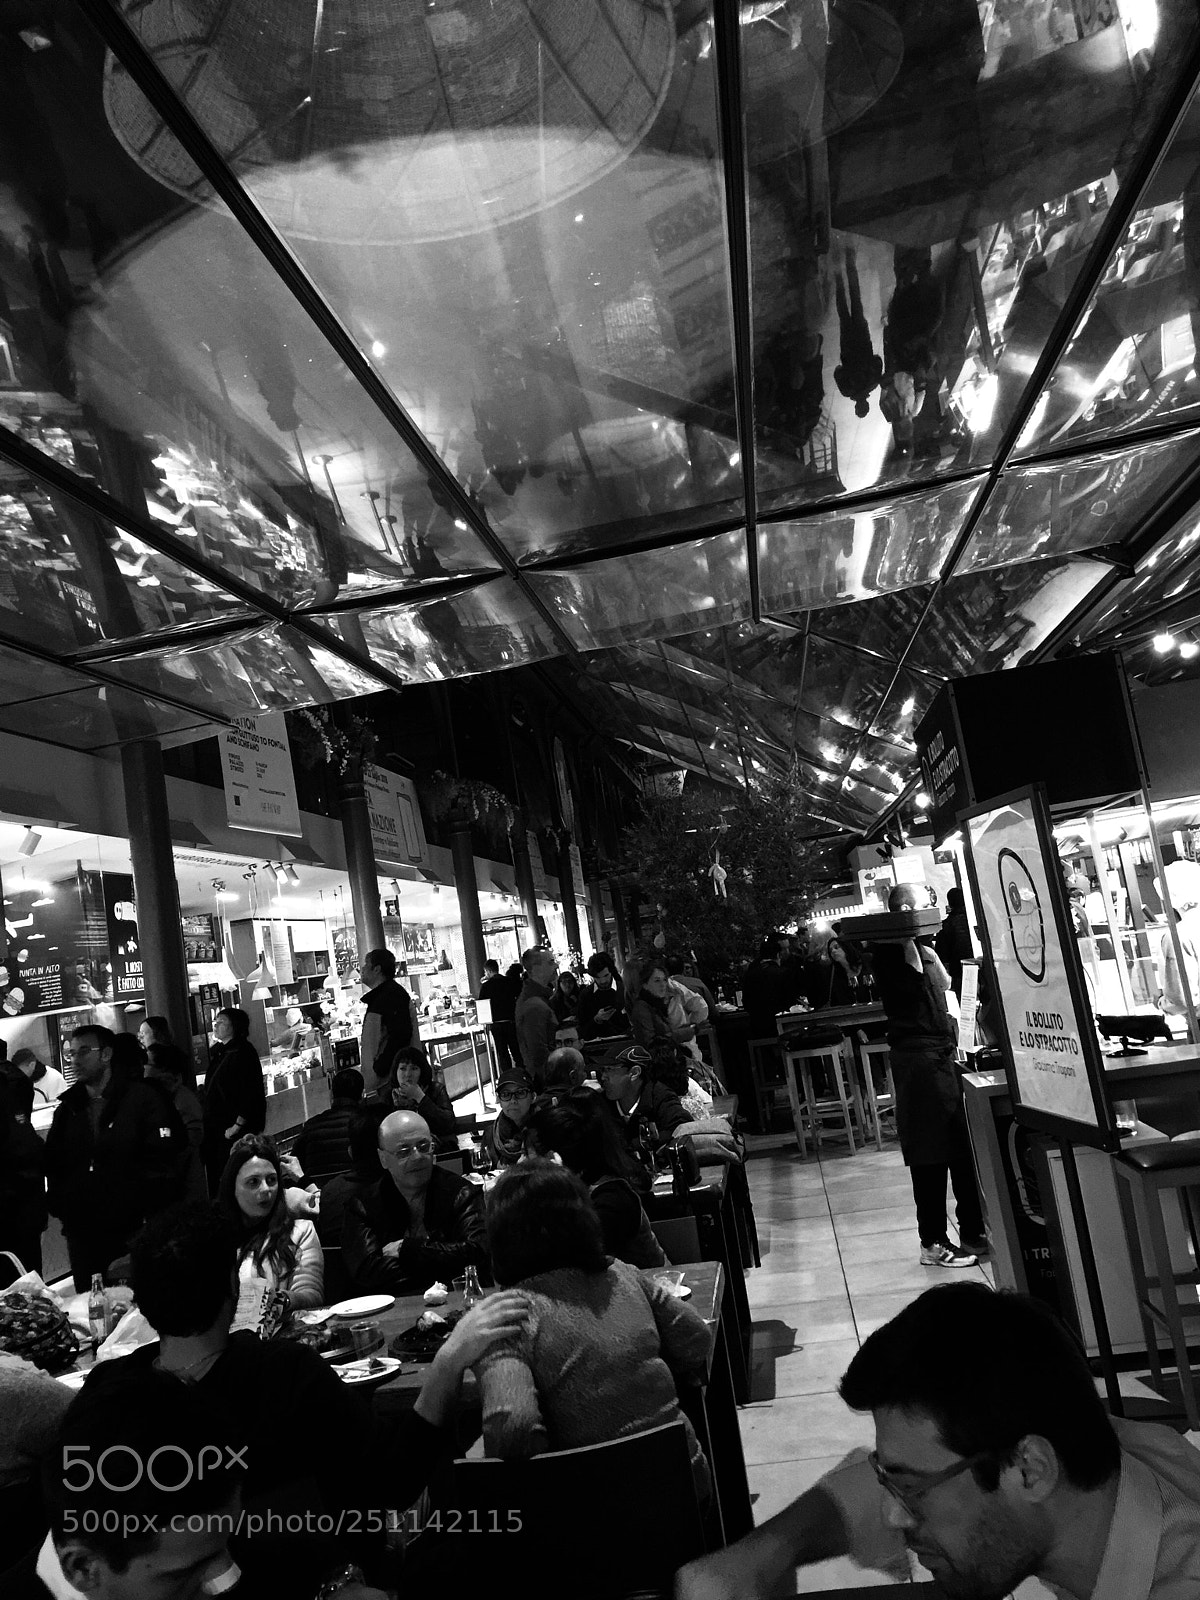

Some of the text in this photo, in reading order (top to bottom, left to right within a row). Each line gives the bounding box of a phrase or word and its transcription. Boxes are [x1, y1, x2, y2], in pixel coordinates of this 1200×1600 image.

[19, 963, 60, 978] PUNTA IN ALTO
[1026, 1011, 1064, 1030] IL BOLLITO
[1019, 1031, 1079, 1055] E LO STRACOTTO
[1032, 1247, 1050, 1259] TR
